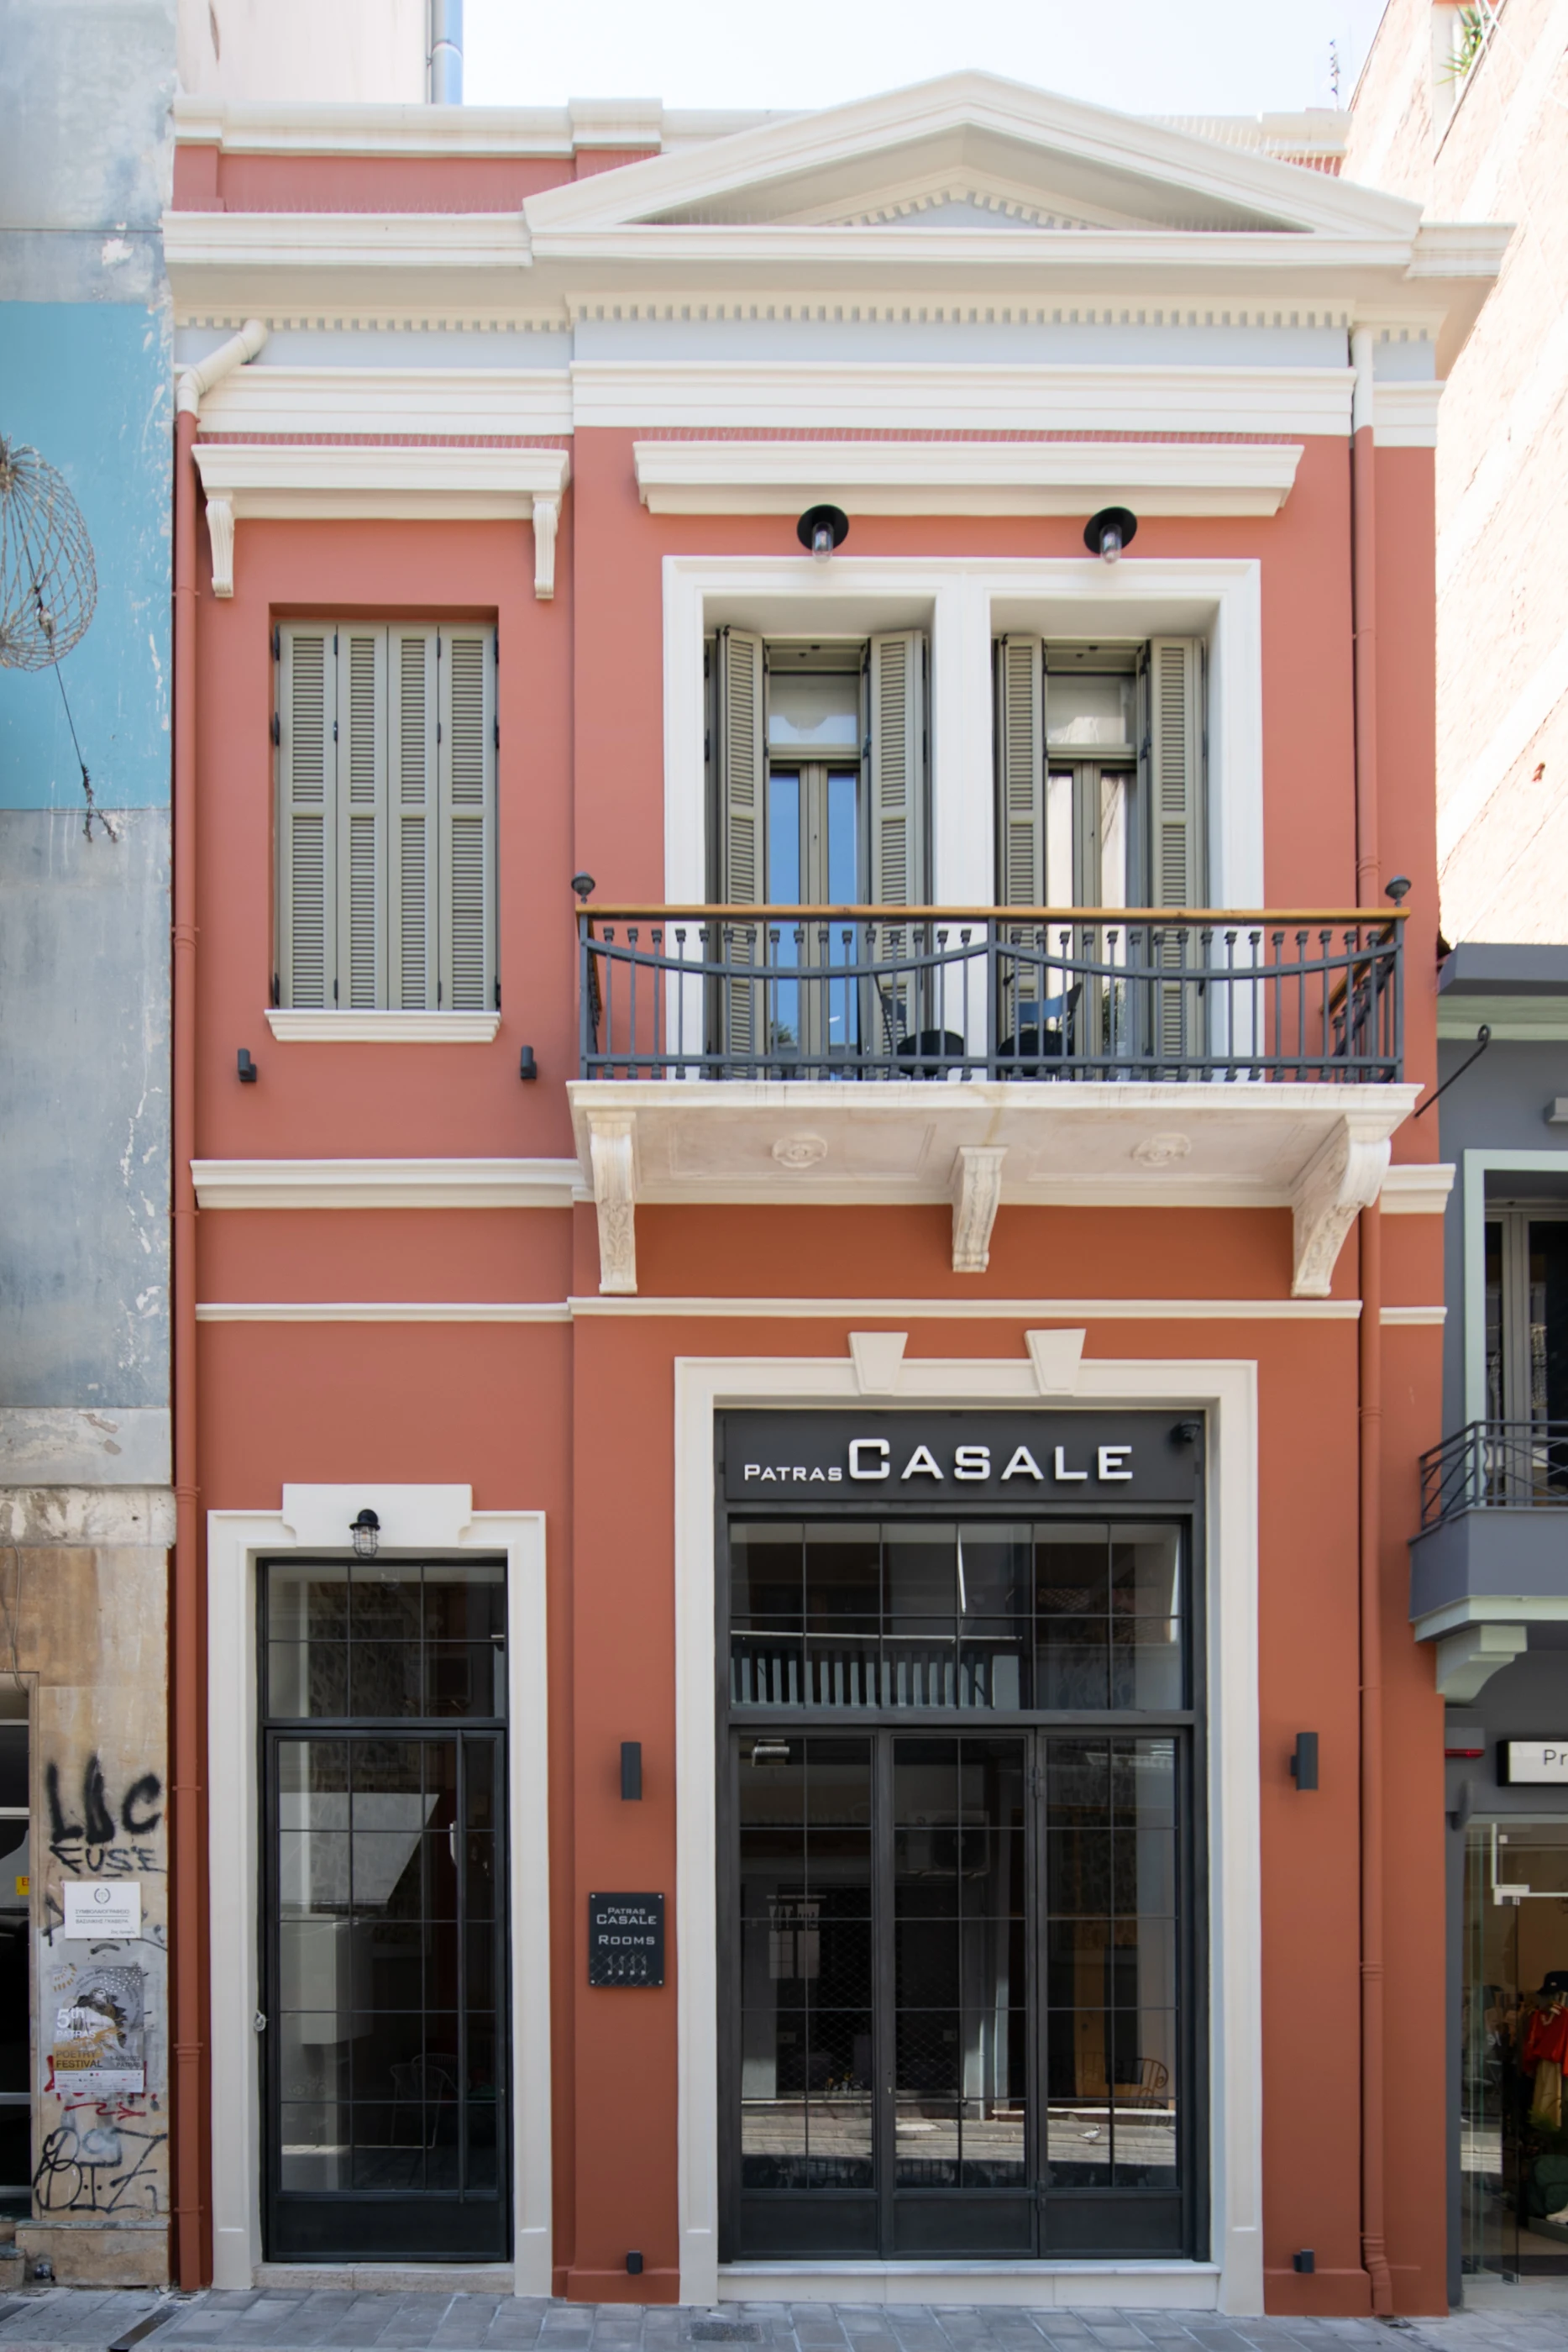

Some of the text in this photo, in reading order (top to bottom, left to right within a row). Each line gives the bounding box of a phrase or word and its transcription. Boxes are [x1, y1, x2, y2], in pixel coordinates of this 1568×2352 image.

[744, 1438, 1133, 1481] PATRAS CASALE
[607, 1907, 646, 1915] PATRAS
[596, 1914, 657, 1925] CASALE
[598, 1935, 656, 1945] ROOMS
[56, 2007, 85, 2029] 5th
[56, 2029, 96, 2039] PATRAS
[55, 2050, 96, 2058] POETRY
[55, 2059, 103, 2068] FESTIVAL
